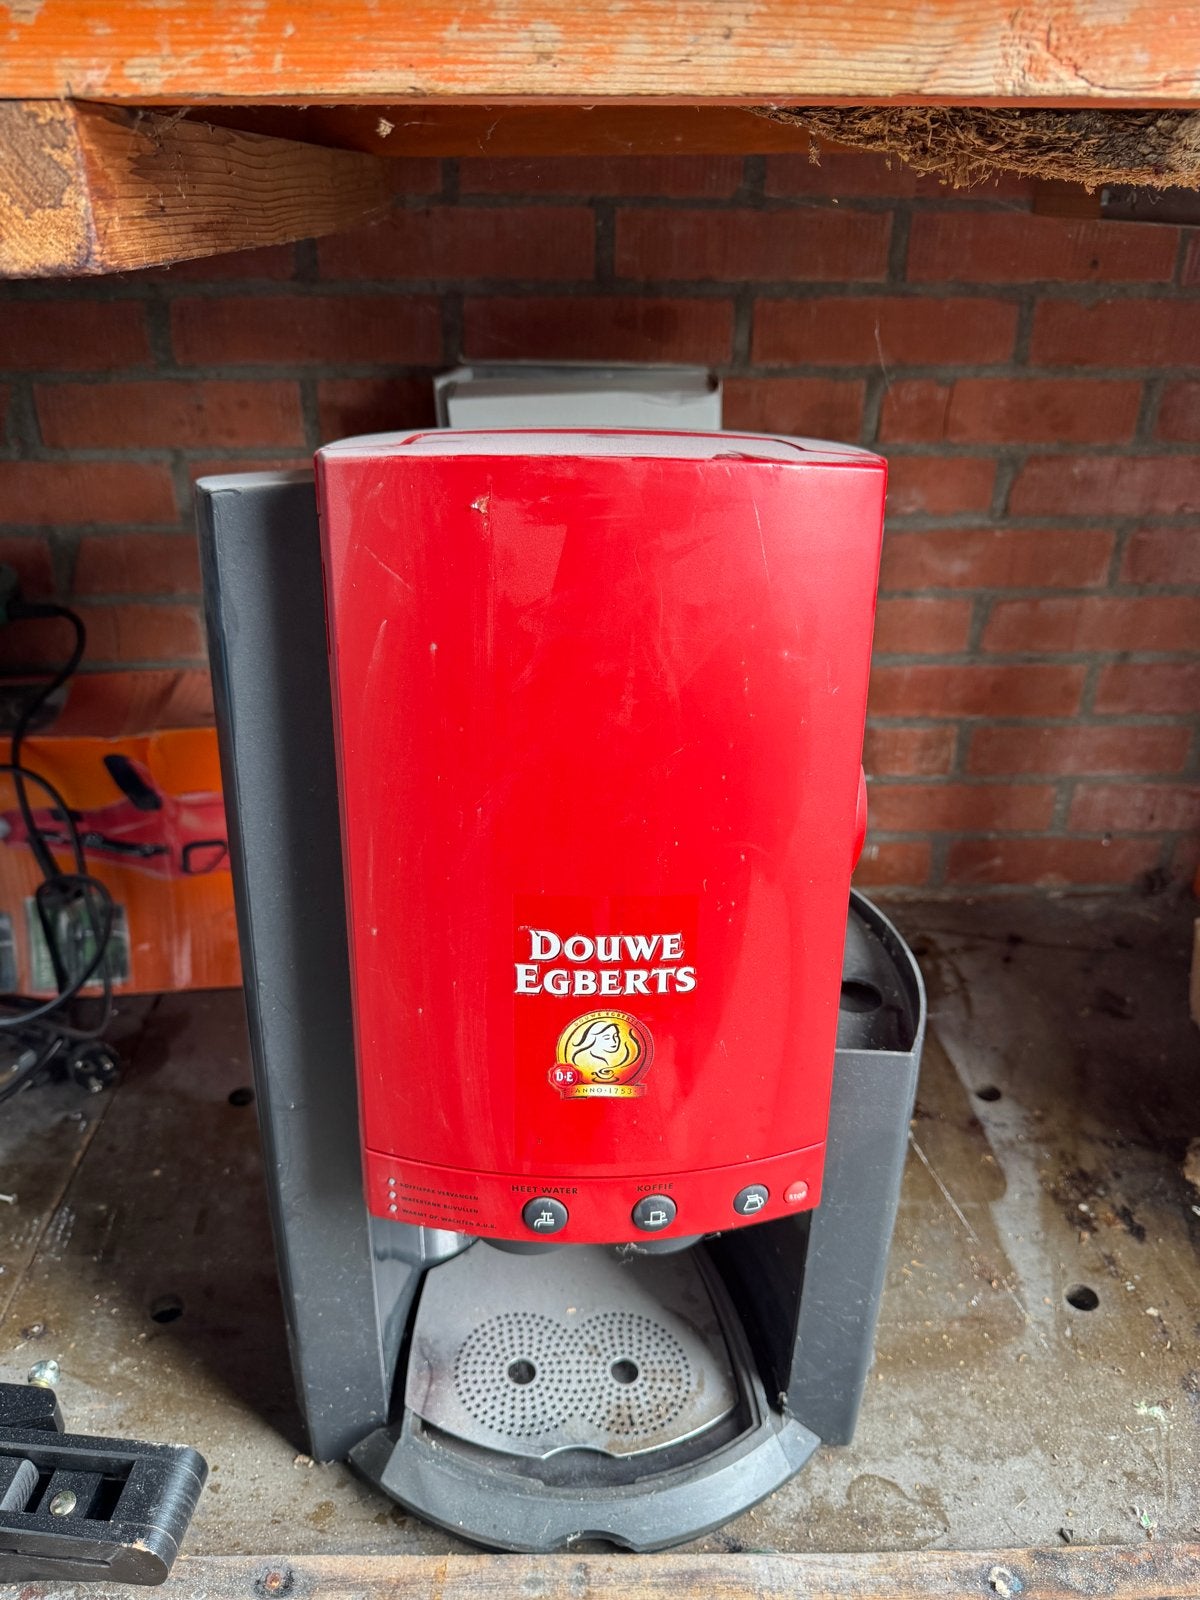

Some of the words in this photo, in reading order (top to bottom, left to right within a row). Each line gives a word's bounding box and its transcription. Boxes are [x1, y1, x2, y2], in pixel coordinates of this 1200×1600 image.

[529, 930, 684, 962] DOUWE
[514, 963, 697, 996] EGBERTS
[511, 1185, 537, 1194] HEET
[541, 1186, 578, 1195] WATER
[636, 1182, 674, 1192] KOFFIE
[789, 1191, 807, 1200] STOP
